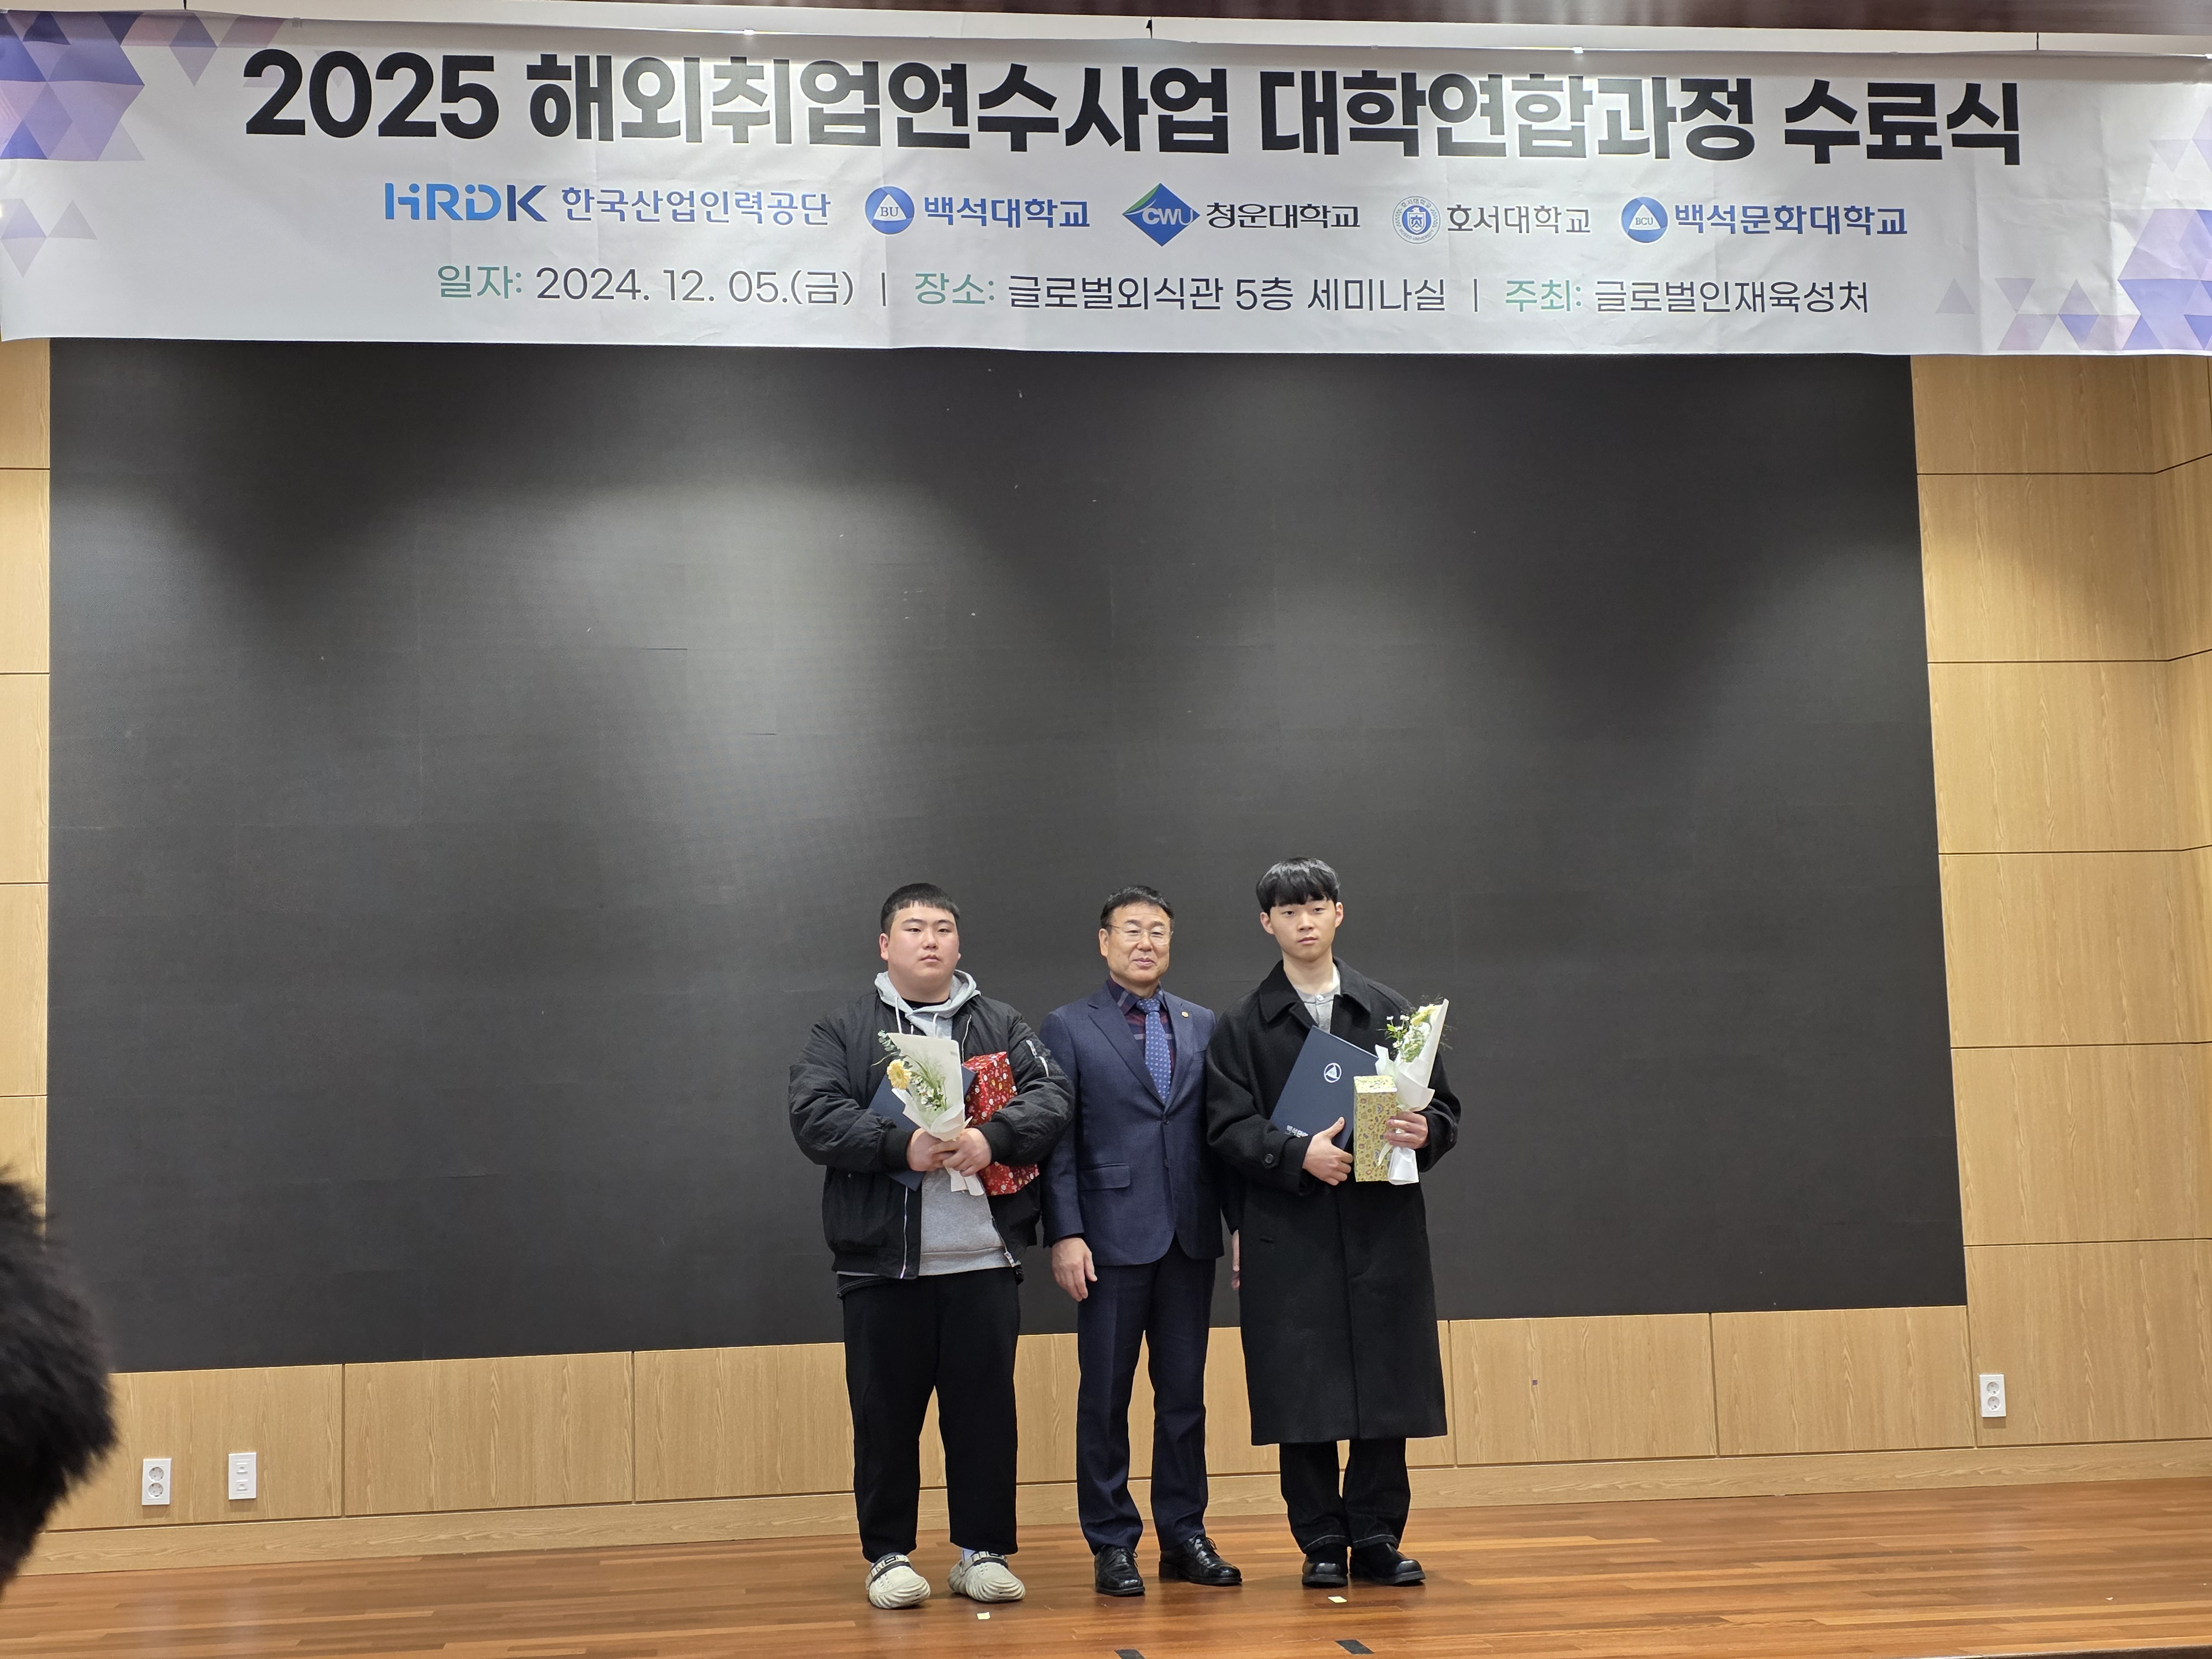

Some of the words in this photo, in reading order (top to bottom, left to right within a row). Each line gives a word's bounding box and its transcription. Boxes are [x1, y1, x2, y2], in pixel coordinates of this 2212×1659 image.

[244, 49, 499, 139] 2025
[526, 54, 1229, 154] 해외취업연수사업
[1260, 70, 1755, 160] 대학연합과정
[1785, 79, 2020, 165] 수료식
[385, 183, 547, 222] HRDK
[562, 186, 831, 225] 한국산업인력공단
[880, 207, 899, 217] BU
[925, 197, 1090, 228] 백석대학교
[1142, 207, 1193, 226] CWU
[1207, 202, 1360, 228] 청운대학교
[1447, 204, 1590, 233] 호서대학교
[1635, 217, 1653, 225] BCU
[1676, 205, 1907, 236] 백석문화대학교
[438, 265, 521, 299] 일자:
[536, 268, 649, 300] 2024.
[664, 270, 714, 301] 12.
[729, 270, 853, 305] 05.(금)
[915, 273, 994, 304] 장소:
[1009, 276, 1223, 310] 글로벌외식관
[1236, 277, 1293, 310] 5층
[1308, 279, 1445, 311] 세미나실
[1506, 280, 1581, 312] 주최:
[1595, 281, 1867, 313] 글로벌인재육성처
